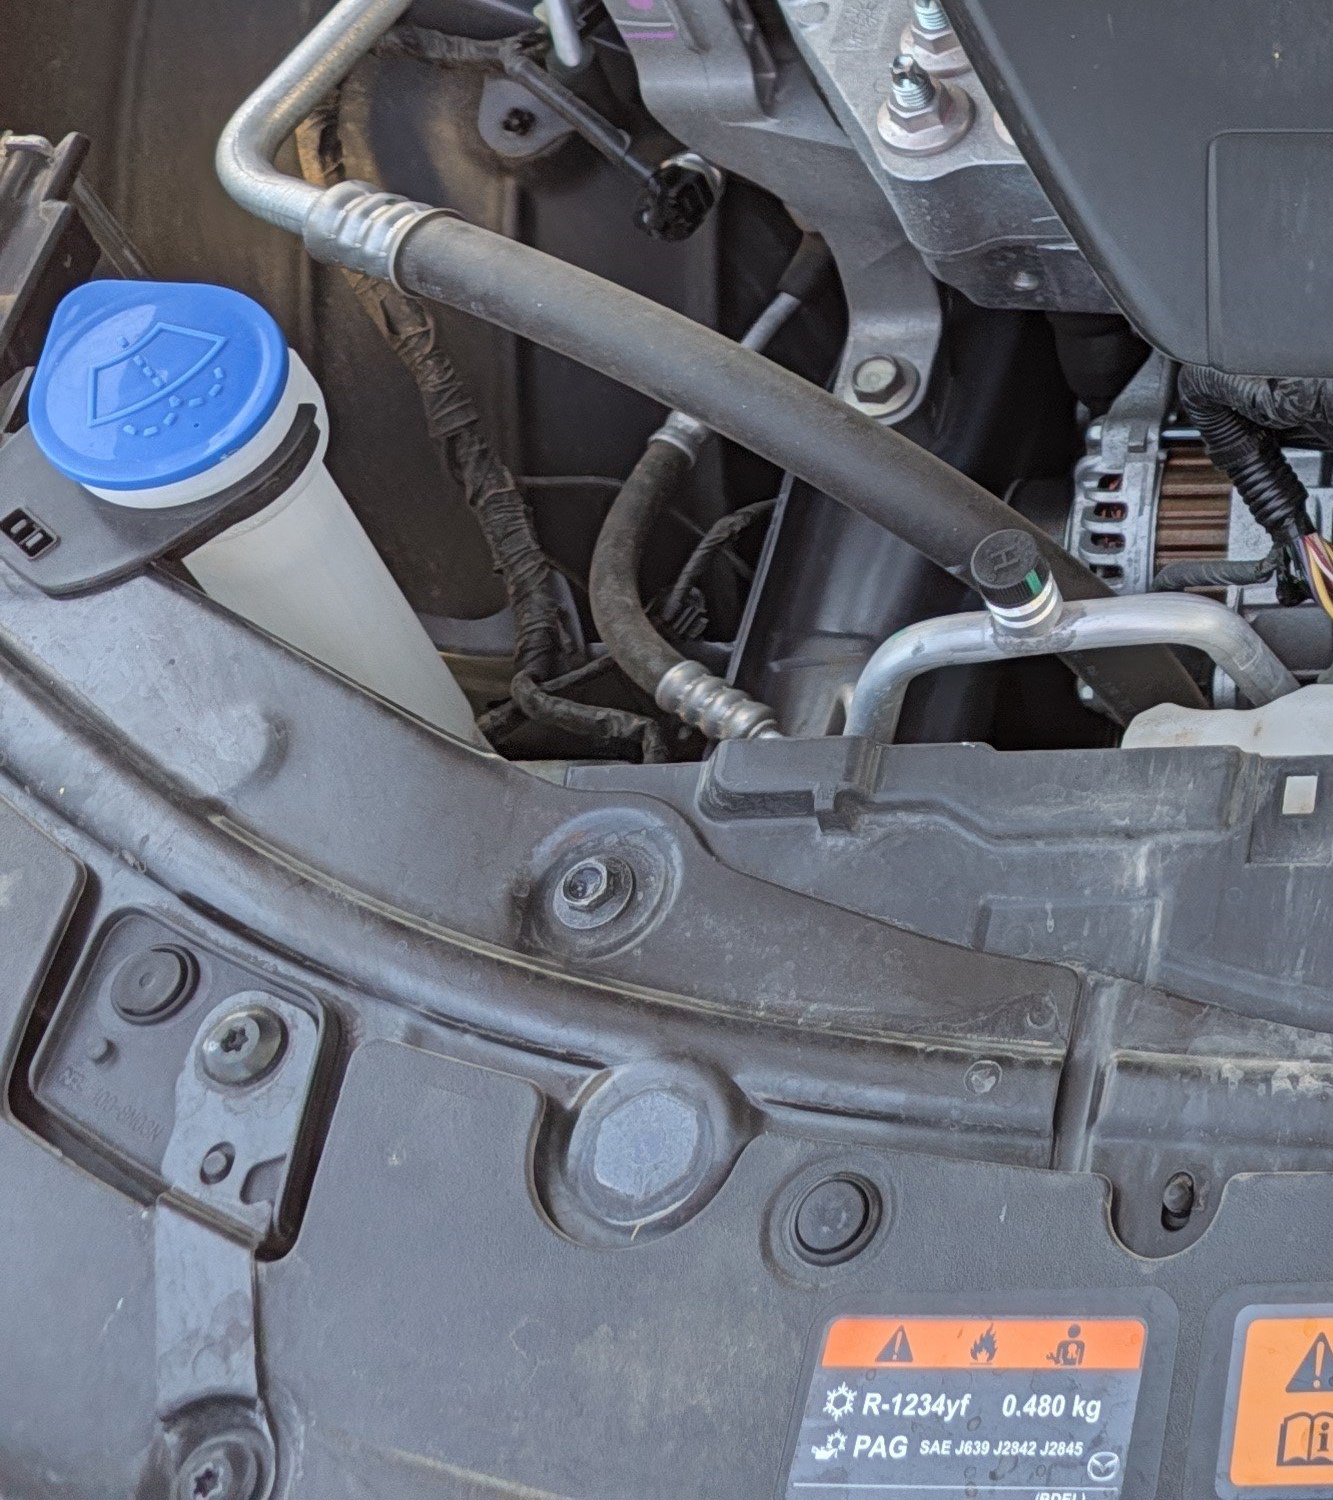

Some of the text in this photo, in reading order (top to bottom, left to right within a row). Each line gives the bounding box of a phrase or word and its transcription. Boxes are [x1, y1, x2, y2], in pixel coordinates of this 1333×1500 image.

[862, 1392, 1101, 1423] R-1234yf 0.480 kg
[853, 1435, 908, 1459] PAG
[919, 1439, 952, 1455] SAE
[955, 1440, 990, 1456] J639
[1039, 1441, 1084, 1457] J2845
